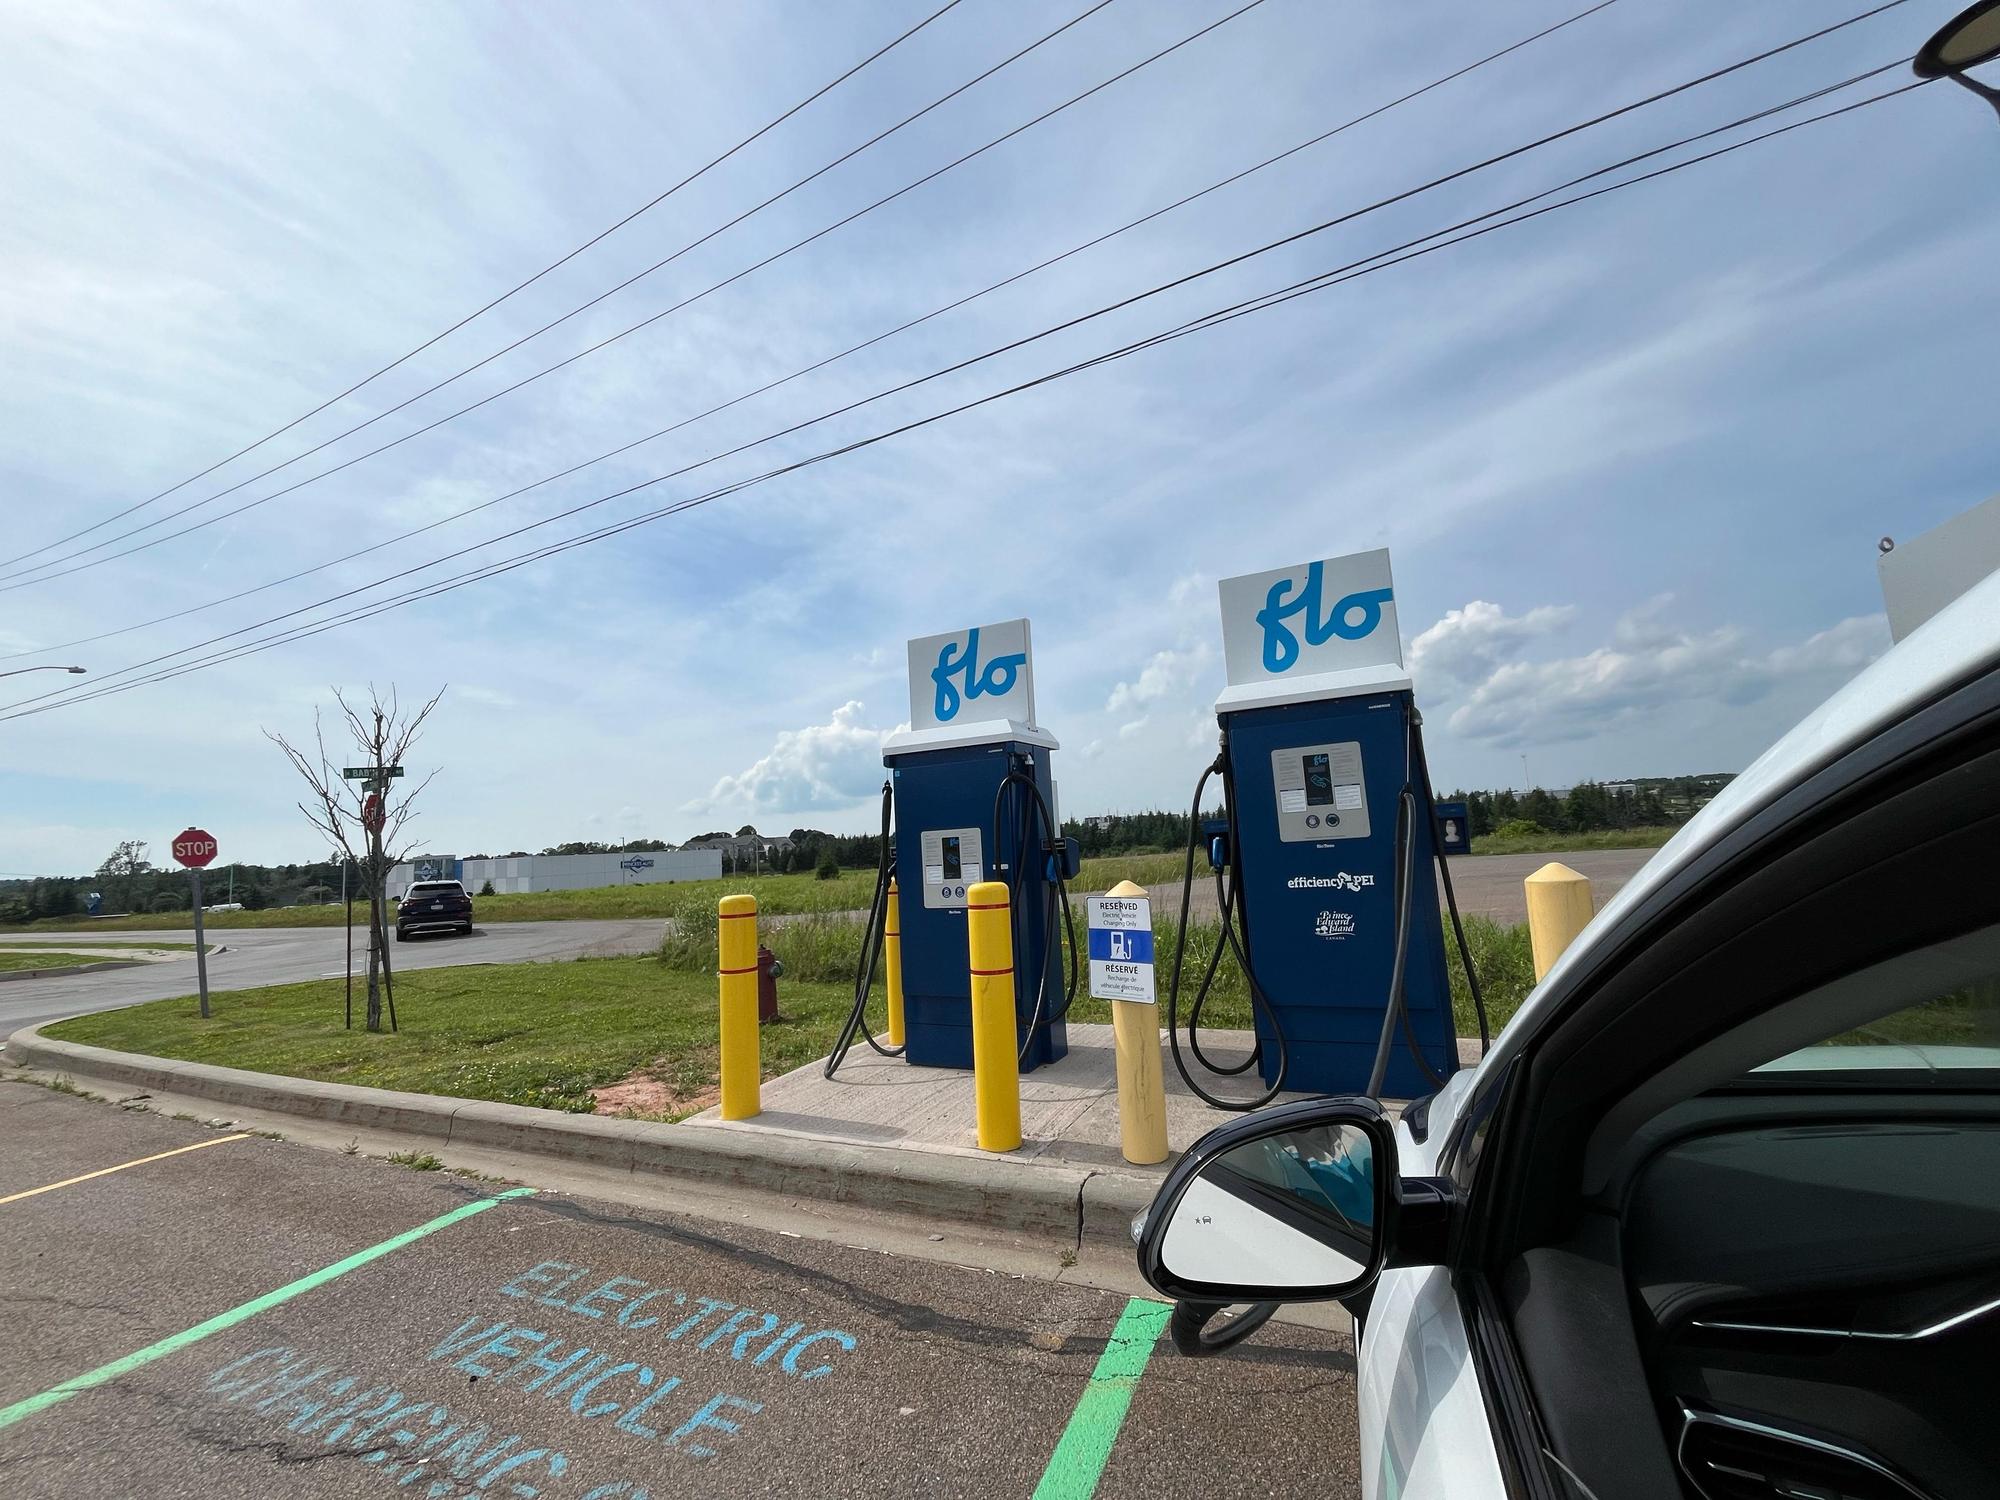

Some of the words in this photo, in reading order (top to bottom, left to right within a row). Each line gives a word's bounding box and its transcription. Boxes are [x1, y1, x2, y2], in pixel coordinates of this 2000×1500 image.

[1256, 560, 1393, 674] flo
[931, 628, 1026, 721] flo
[175, 841, 215, 857] STOP
[1100, 902, 1138, 910] RESERVED
[1287, 876, 1344, 890] efficiency
[1353, 875, 1375, 886] PEI
[1105, 964, 1138, 975] RÉSERVÉ
[500, 1261, 857, 1379] ELECTRIC
[428, 1315, 763, 1458] VEHICLE
